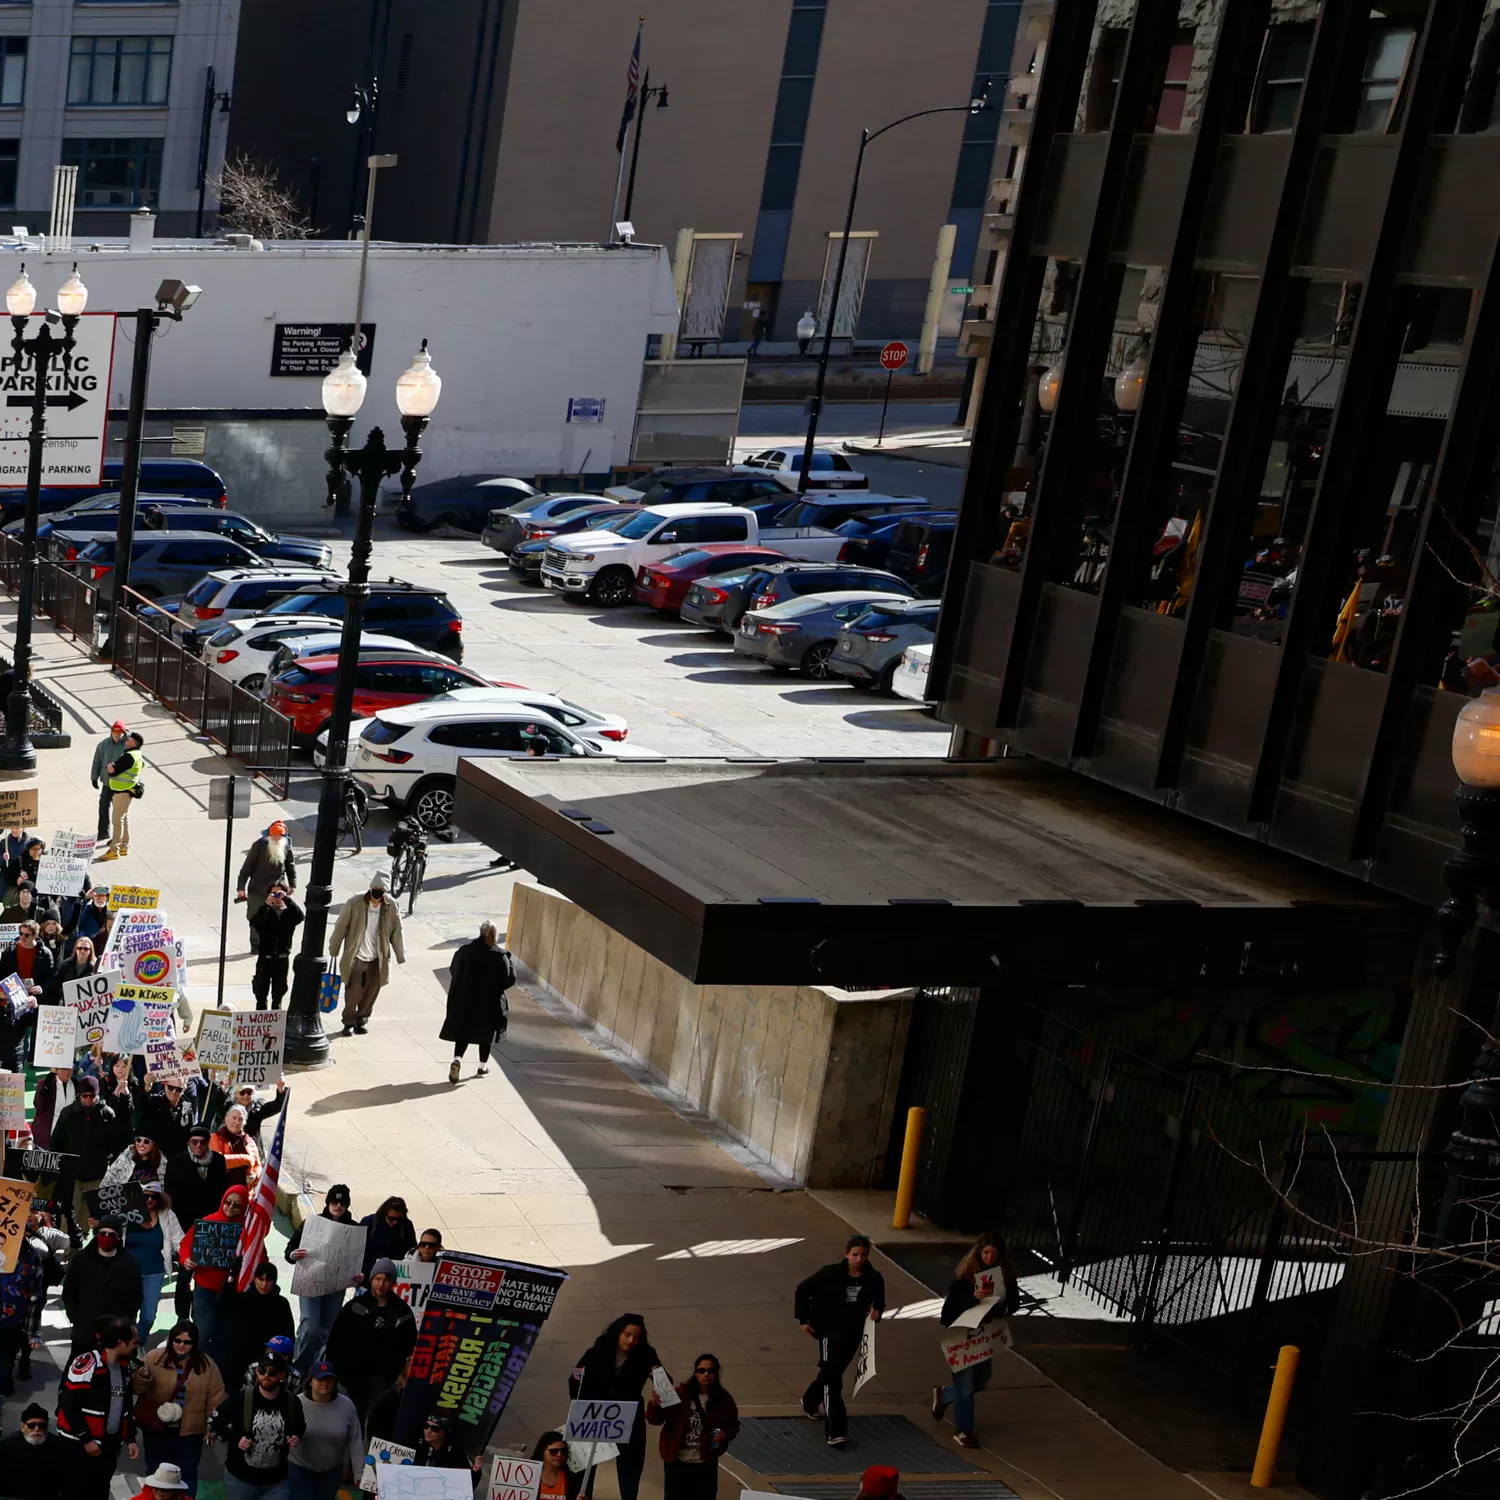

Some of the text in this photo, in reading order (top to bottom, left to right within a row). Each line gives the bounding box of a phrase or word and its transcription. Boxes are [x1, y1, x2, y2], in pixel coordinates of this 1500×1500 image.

[284, 326, 322, 337] Warning!
[48, 465, 91, 474] PARKING
[113, 894, 156, 906] RESIST
[236, 1014, 243, 1024] 4
[237, 1025, 272, 1038] RELEASE
[238, 1039, 255, 1051] THE
[238, 1050, 279, 1065] EPSTEIN
[236, 1067, 266, 1083] FILES
